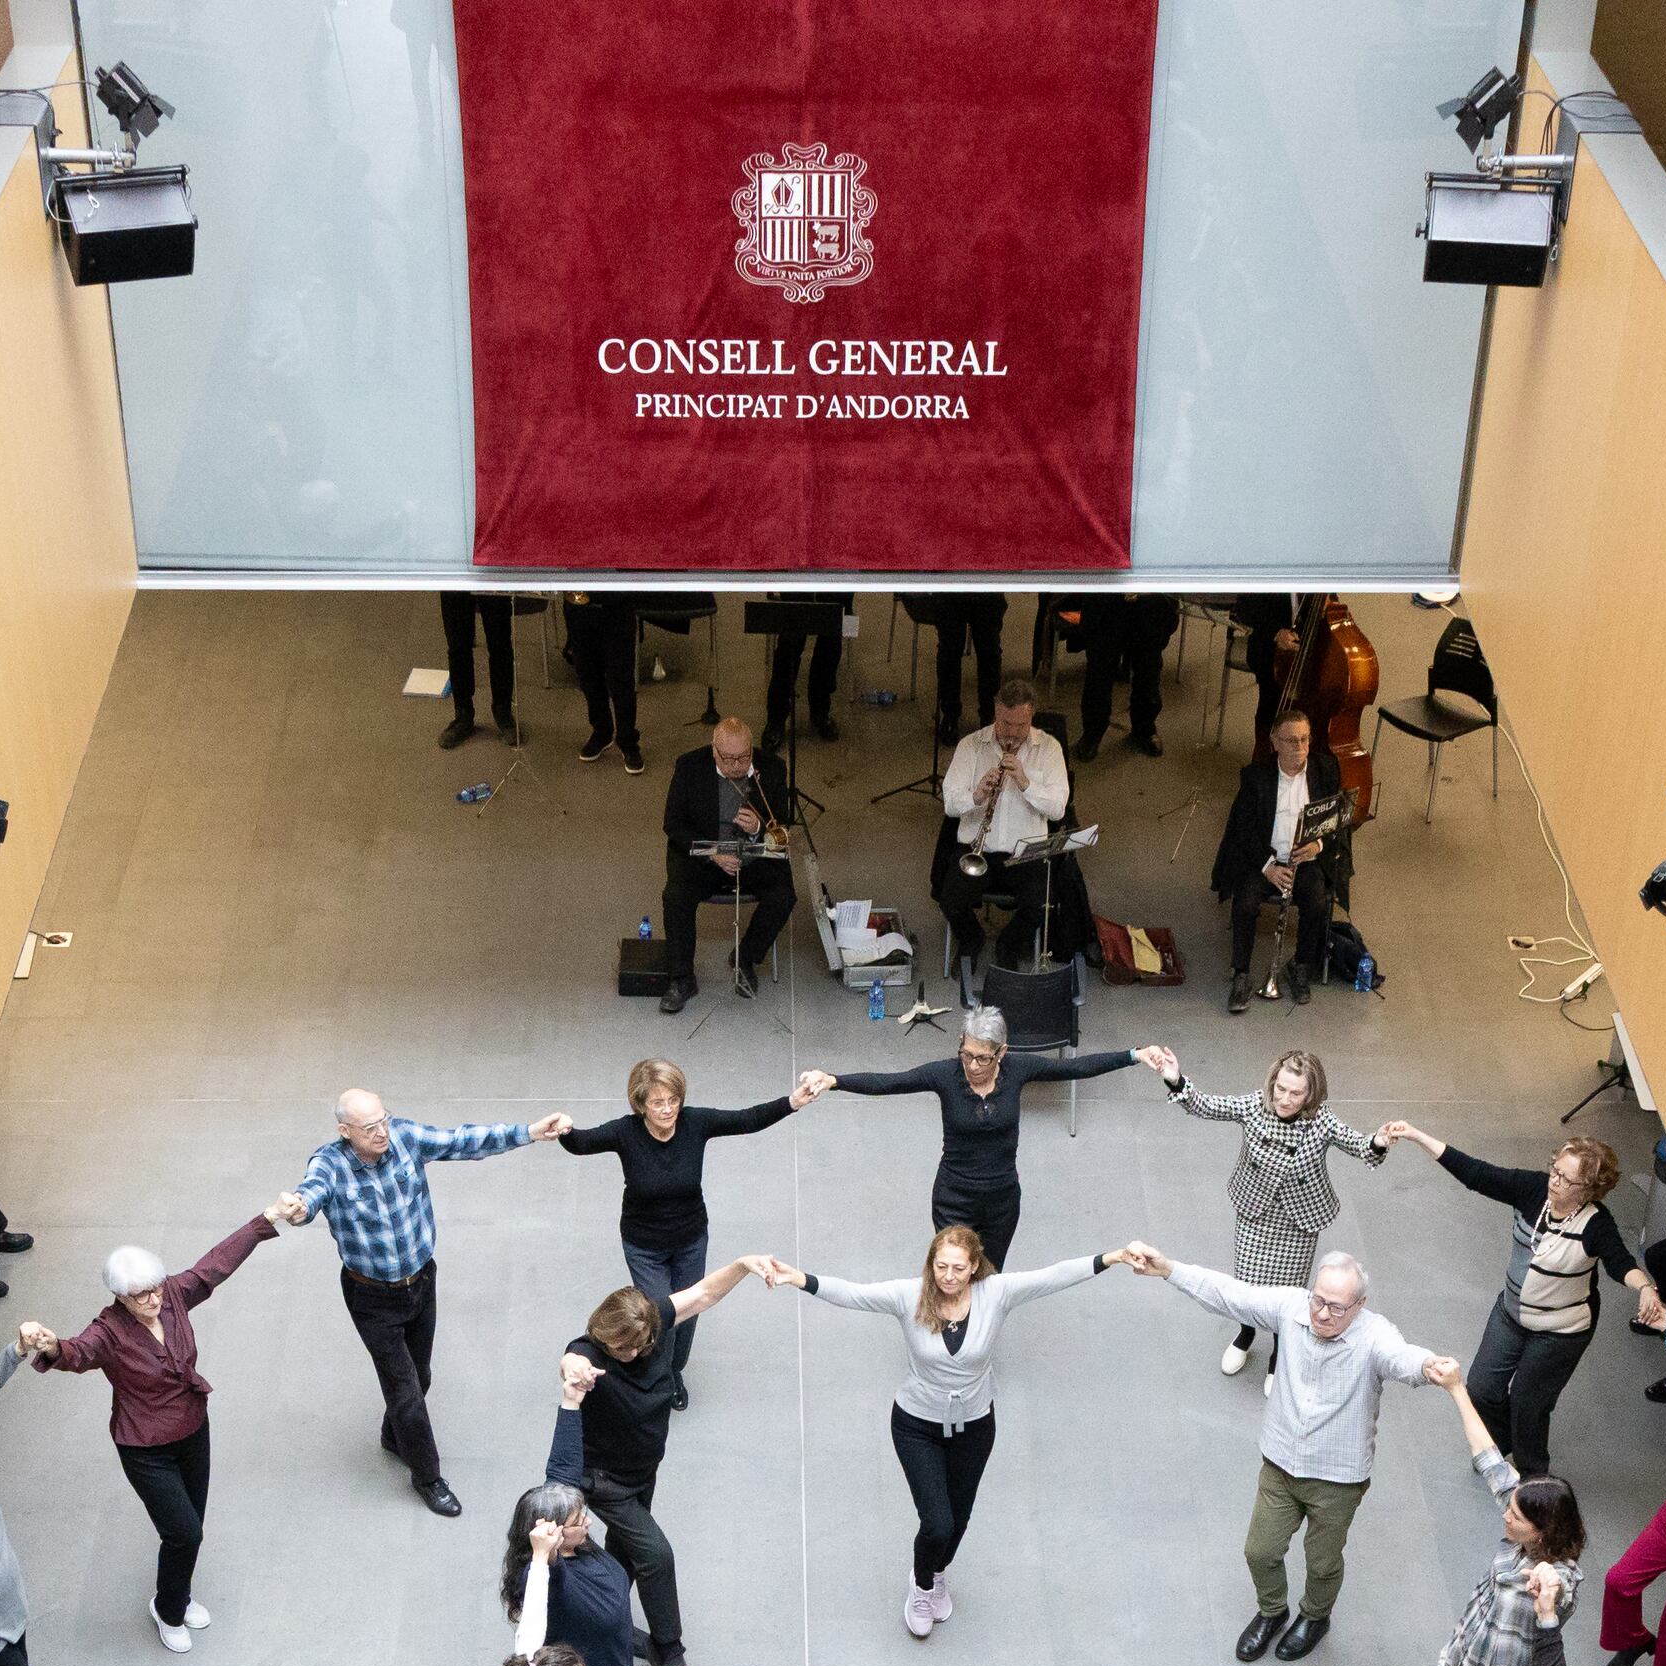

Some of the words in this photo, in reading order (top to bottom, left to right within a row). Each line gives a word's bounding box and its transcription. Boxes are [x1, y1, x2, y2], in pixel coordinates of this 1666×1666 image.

[598, 338, 796, 375] CONSELL
[808, 339, 1008, 376] GENERAL
[635, 393, 788, 419] PRINCIPAT
